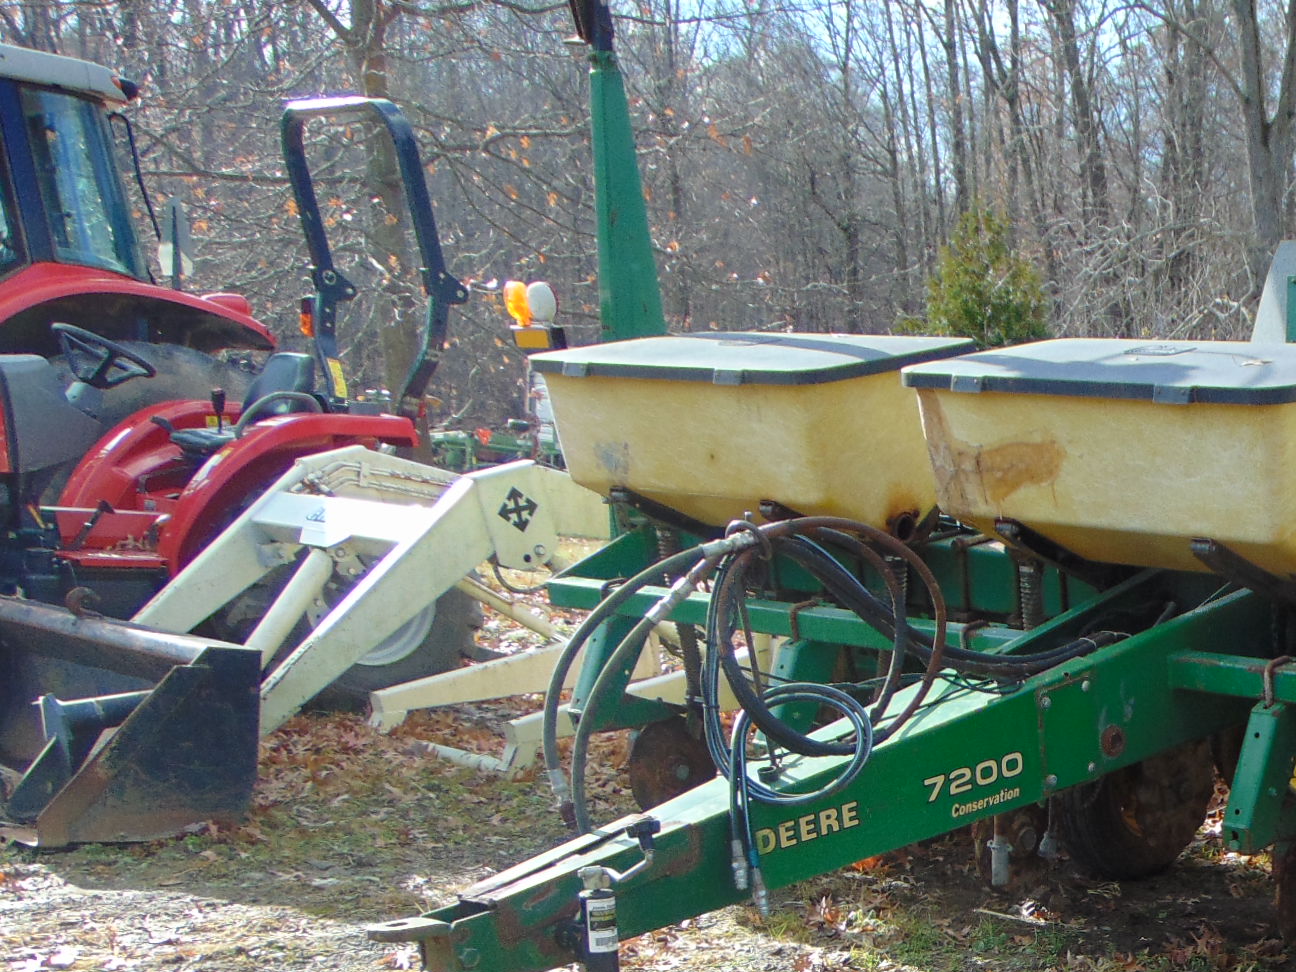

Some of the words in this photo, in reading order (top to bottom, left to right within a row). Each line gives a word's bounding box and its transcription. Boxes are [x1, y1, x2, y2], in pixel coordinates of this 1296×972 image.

[924, 751, 1023, 802] 7200
[951, 787, 1020, 818] Conservation
[755, 801, 860, 856] DEERE
